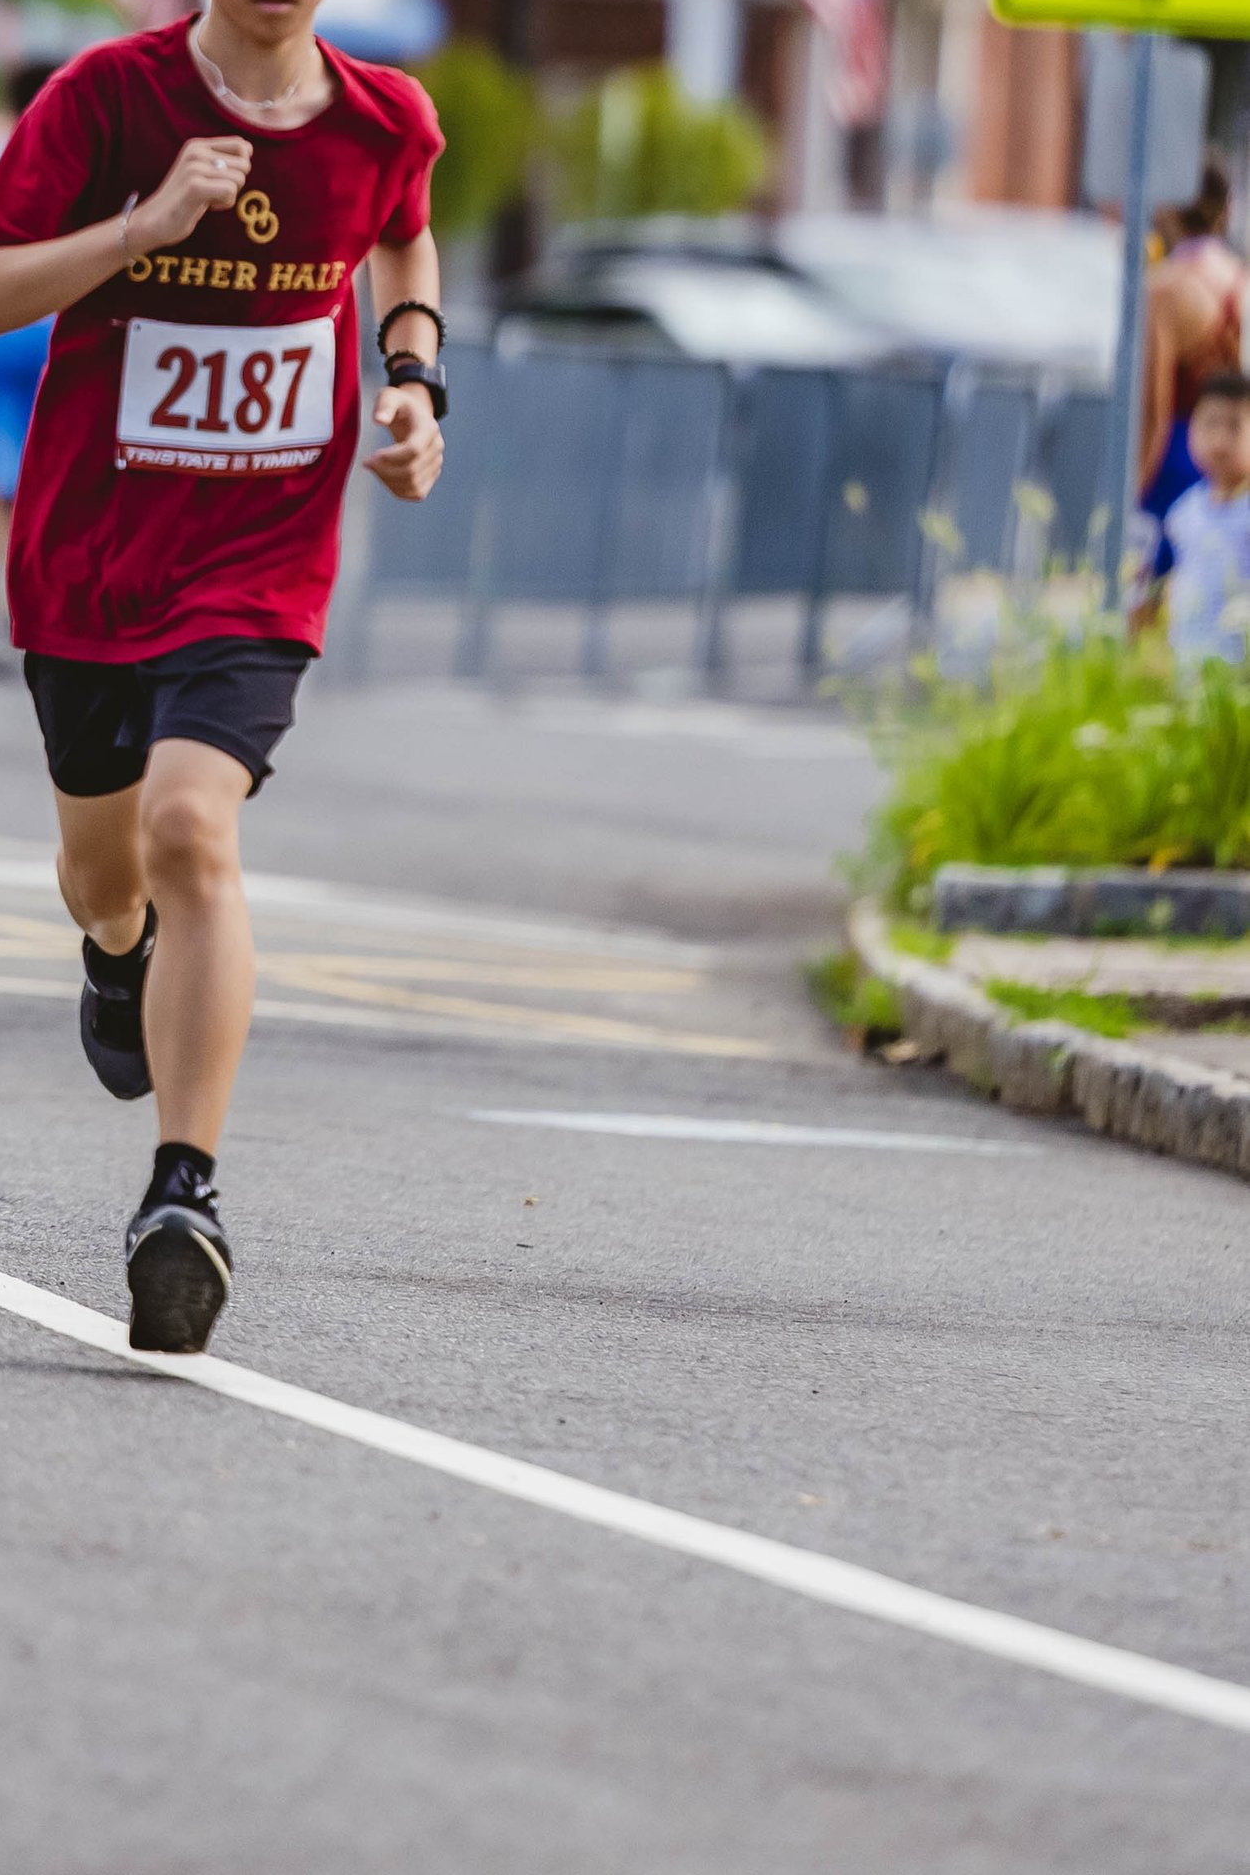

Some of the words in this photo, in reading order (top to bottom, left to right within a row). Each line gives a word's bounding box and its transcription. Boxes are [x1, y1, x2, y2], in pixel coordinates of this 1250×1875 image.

[128, 255, 258, 291] OTHER
[150, 346, 312, 433] 2187
[126, 445, 231, 471] TRISTATE
